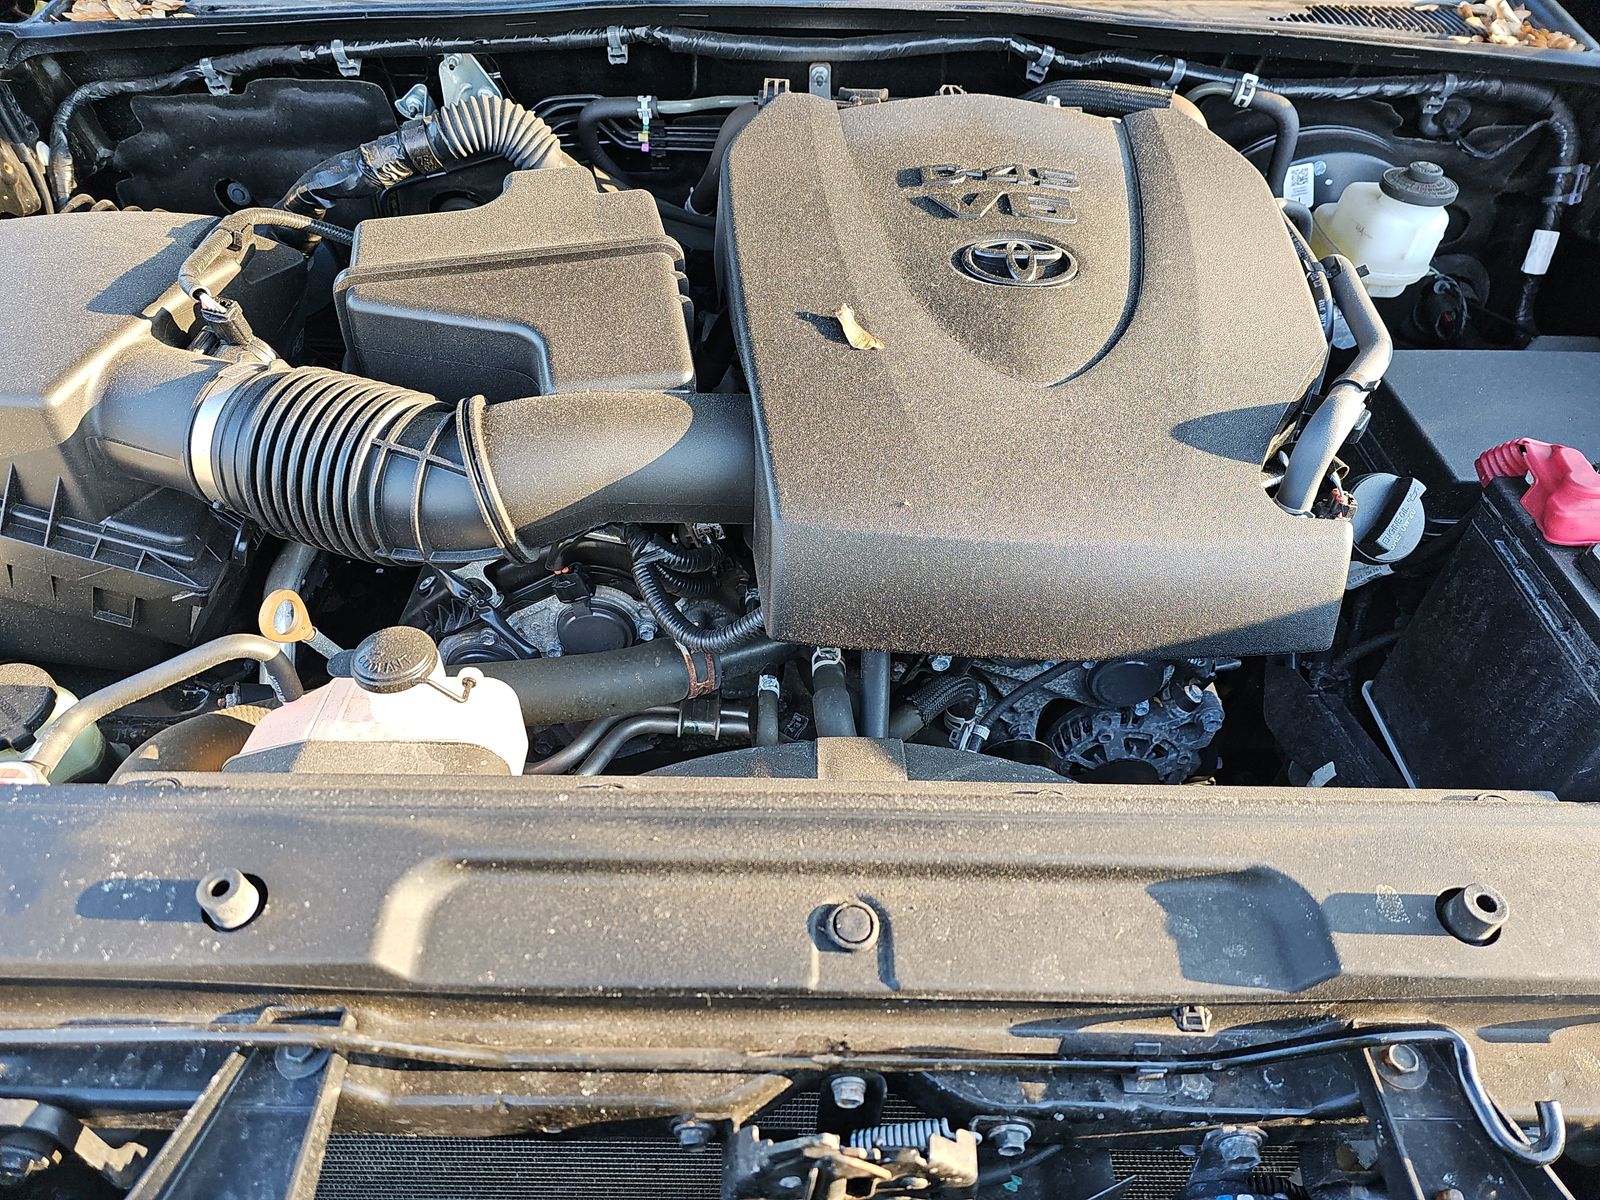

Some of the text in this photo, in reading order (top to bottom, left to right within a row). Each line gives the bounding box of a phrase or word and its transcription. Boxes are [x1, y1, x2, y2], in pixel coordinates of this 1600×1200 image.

[925, 191, 1078, 224] V6
[1382, 505, 1411, 546] ENGINE OIL
[358, 654, 412, 673] COOLANT
